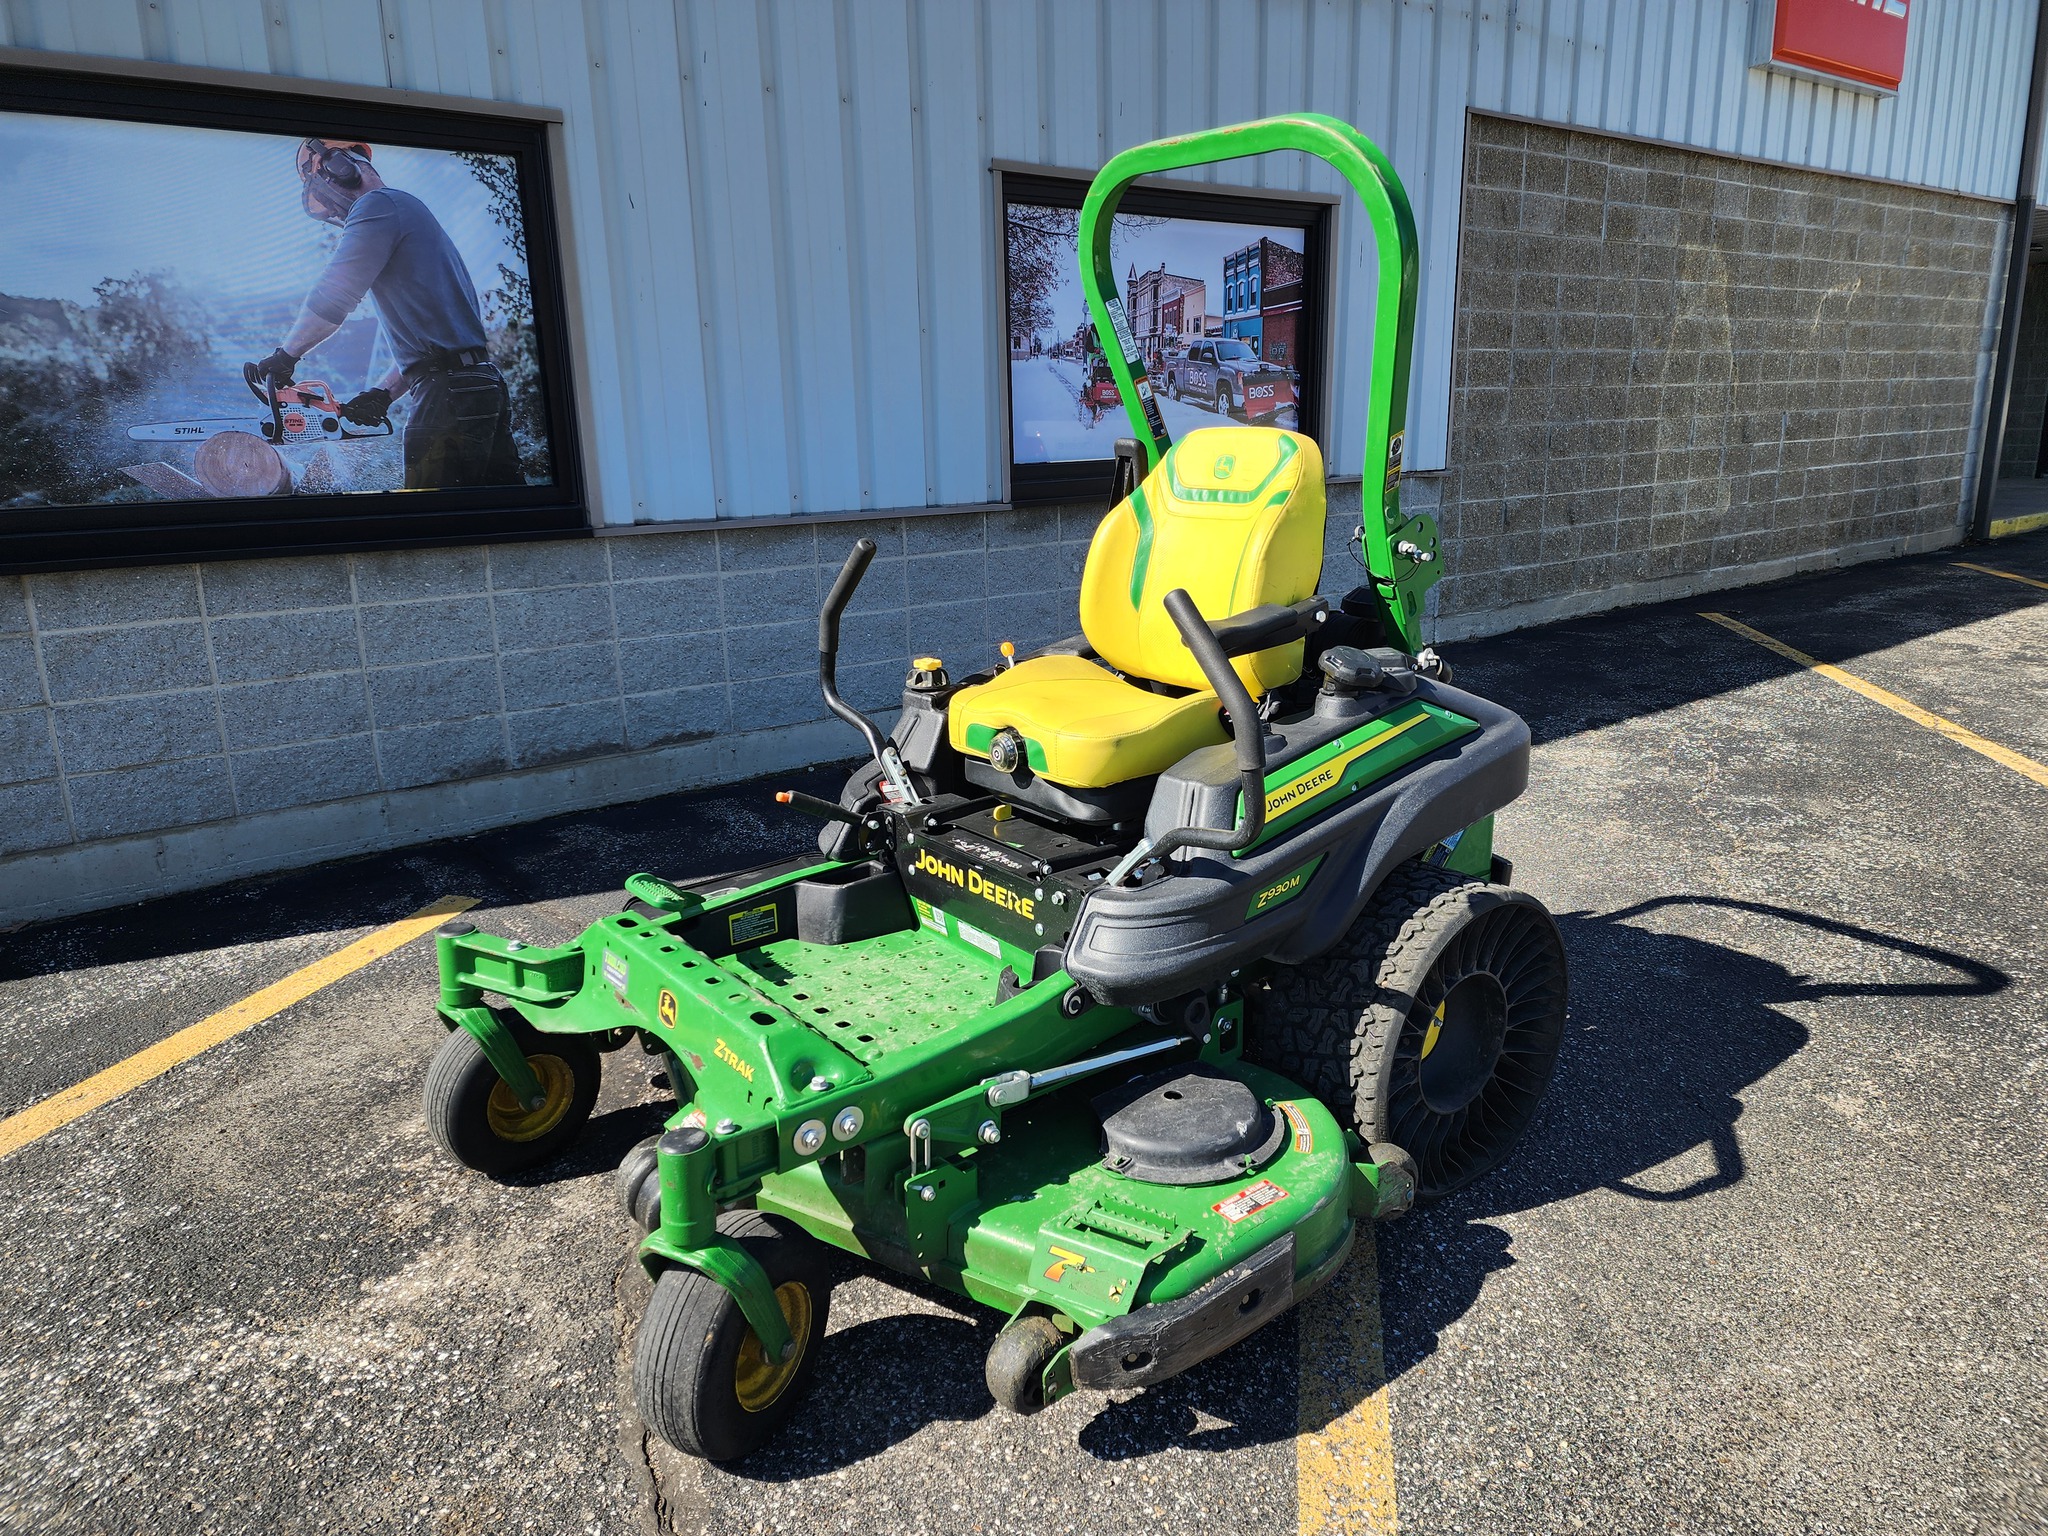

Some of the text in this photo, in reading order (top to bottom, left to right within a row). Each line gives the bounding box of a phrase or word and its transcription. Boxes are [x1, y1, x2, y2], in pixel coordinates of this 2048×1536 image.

[1189, 371, 1207, 387] BOSS
[1249, 385, 1274, 399] BOSS
[174, 427, 205, 435] STIHL
[1267, 769, 1334, 813] JOHN DEERE
[915, 848, 964, 888] JOHN
[967, 867, 1035, 920] DEERE
[1257, 874, 1301, 909] Z930M
[713, 1037, 756, 1083] ZTRAK
